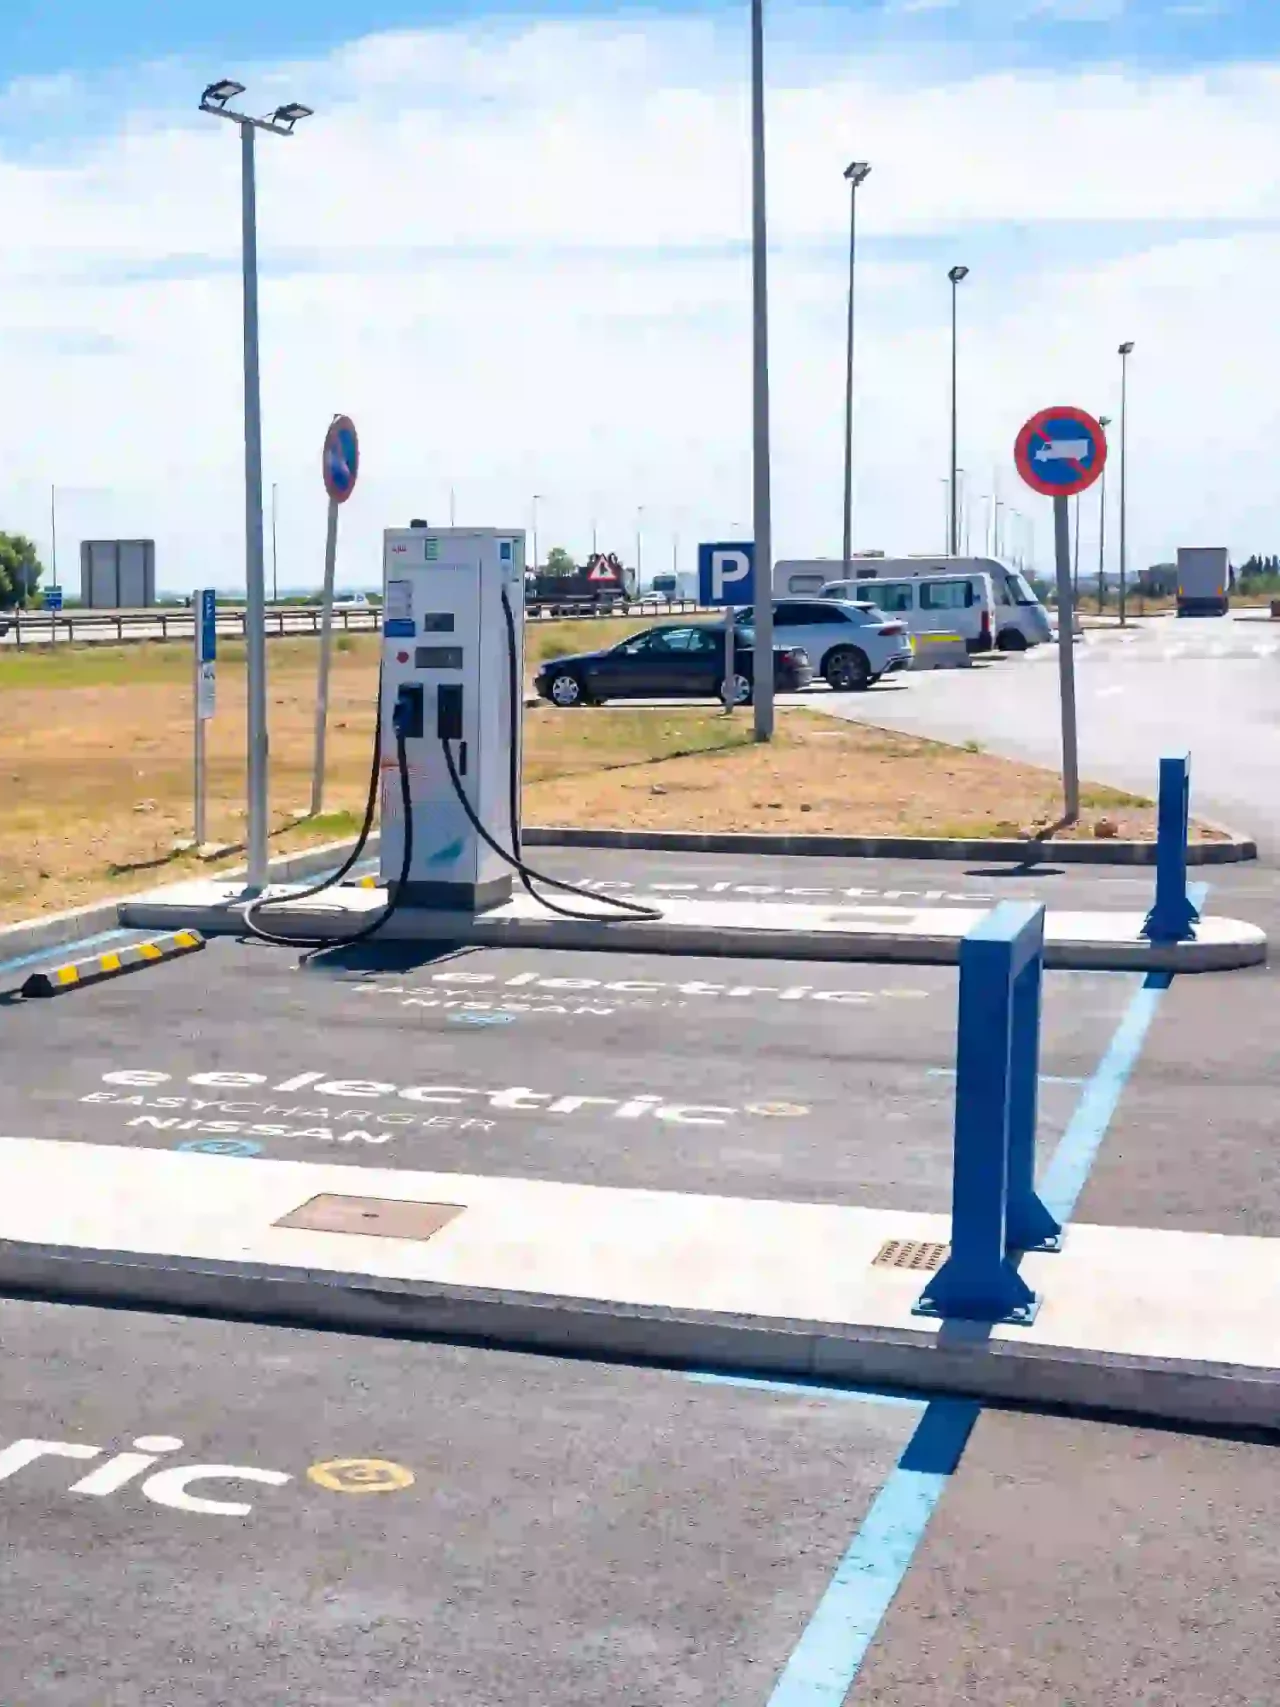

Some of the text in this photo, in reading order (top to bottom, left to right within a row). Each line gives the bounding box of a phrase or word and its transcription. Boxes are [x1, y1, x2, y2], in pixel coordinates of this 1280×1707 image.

[712, 551, 750, 599] P
[432, 972, 878, 1003] electric
[402, 998, 615, 1014] NISSAN
[78, 1091, 497, 1131] EASYCHARGER
[123, 1115, 394, 1143] NISSAN
